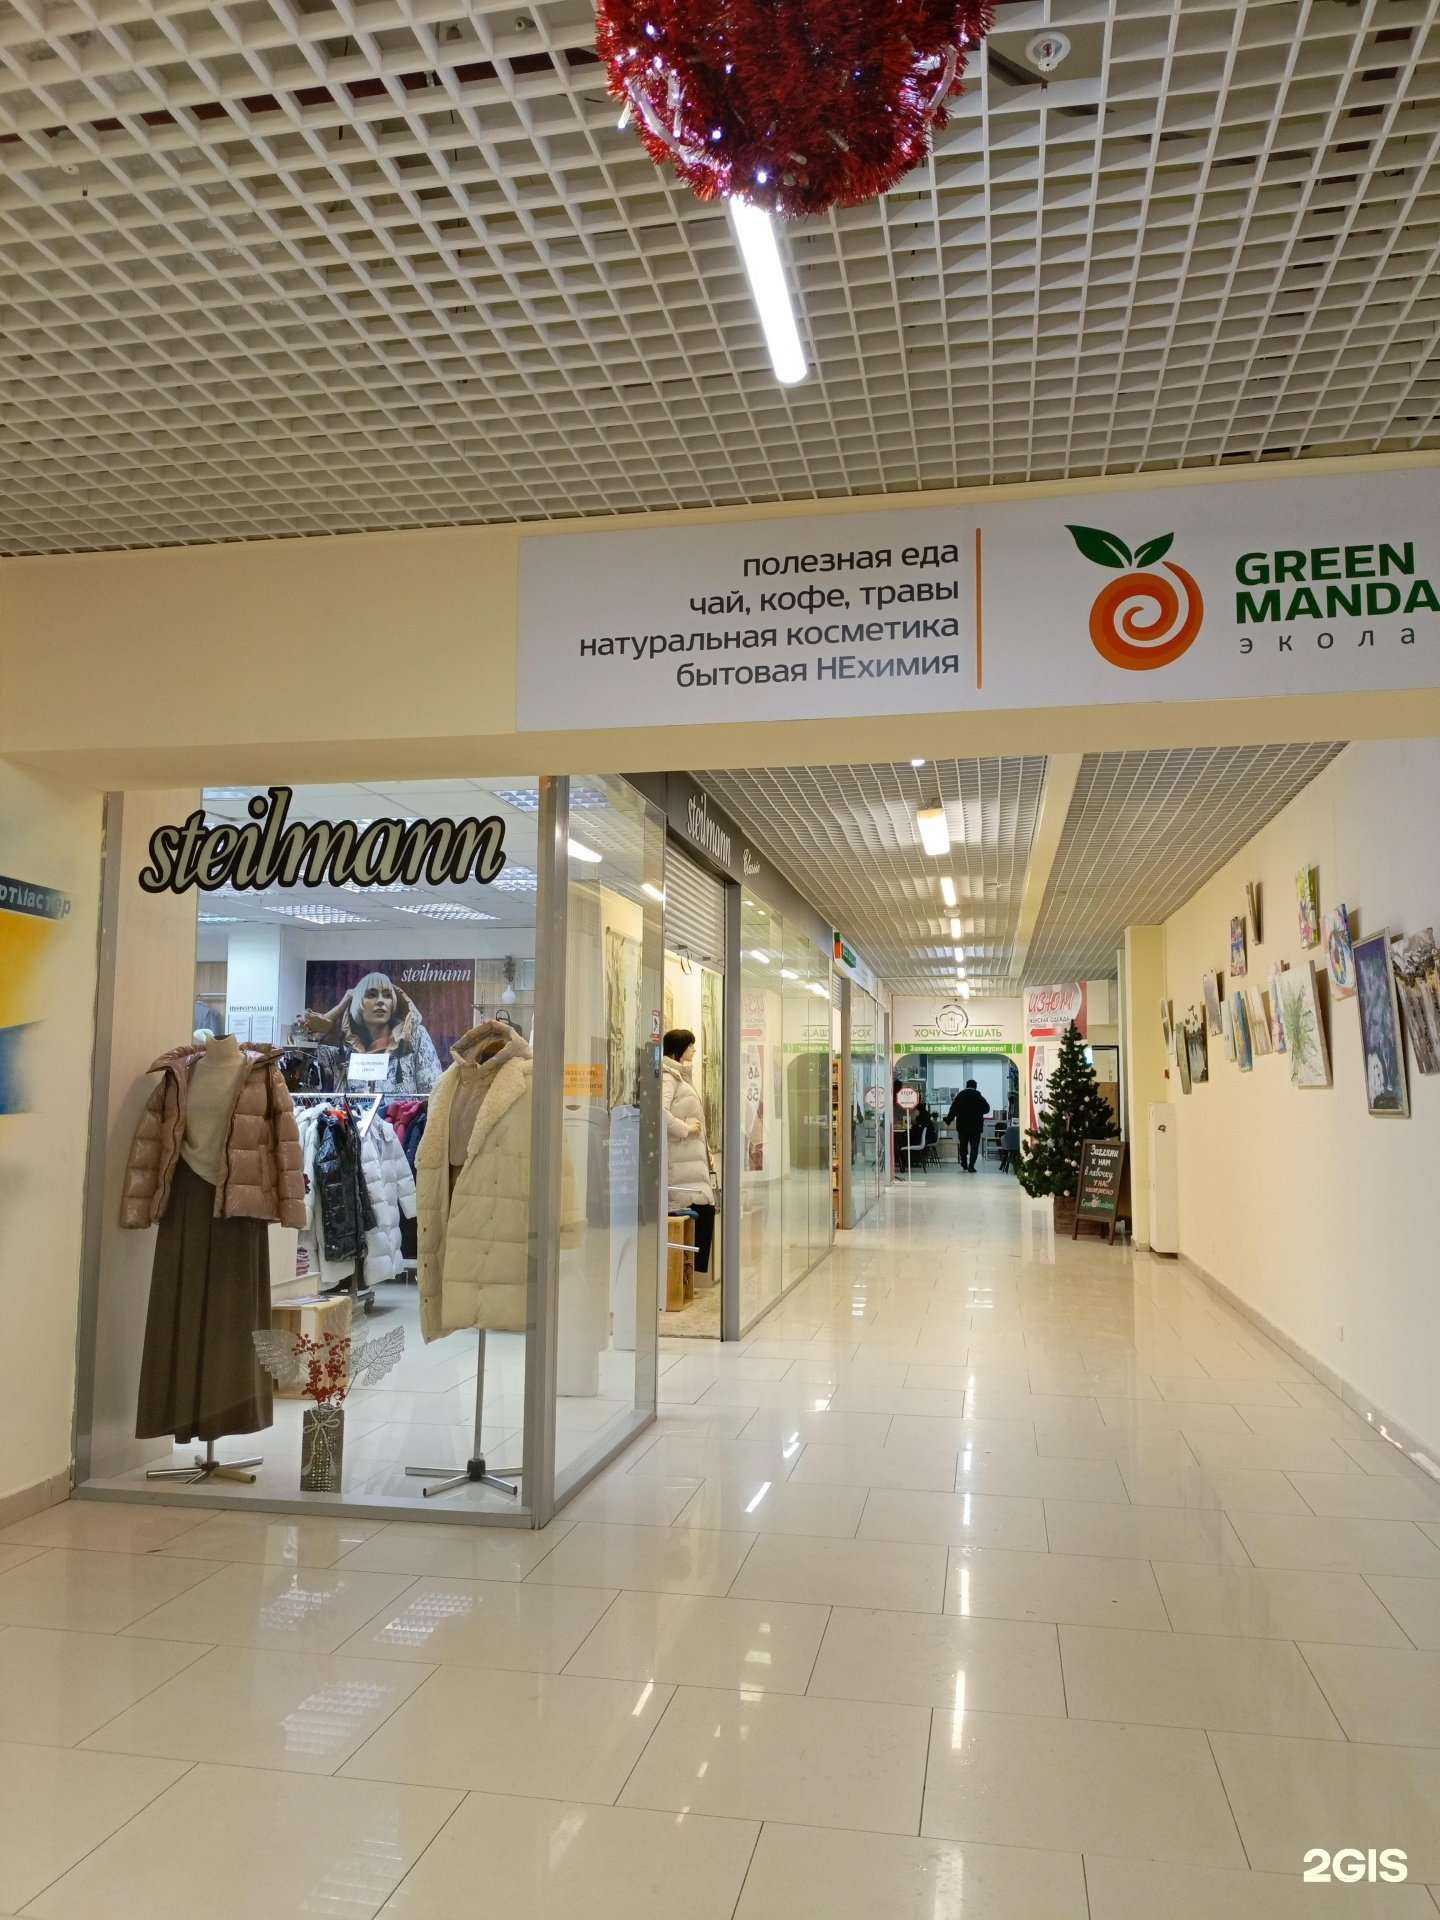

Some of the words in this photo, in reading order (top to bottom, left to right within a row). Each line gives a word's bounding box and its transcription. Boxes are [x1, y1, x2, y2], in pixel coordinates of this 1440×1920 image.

[743, 549, 892, 577] полезная
[901, 544, 959, 568] еда
[1235, 541, 1415, 586] GREEN
[690, 590, 751, 616] чай,
[760, 584, 850, 615] кофе,
[860, 580, 959, 609] травы
[1236, 579, 1440, 625] MANDA
[580, 625, 778, 660] натуральная
[786, 617, 959, 647] косметика
[677, 661, 807, 687] бытовая
[816, 653, 959, 681] НЕхимия
[139, 786, 506, 894] steilmann
[688, 792, 730, 868] steilmann
[401, 962, 472, 982] steilmann
[913, 1028, 941, 1038] ХОЧУ
[961, 1028, 1003, 1038] КУШАТЬ
[1033, 1068, 1044, 1082] 46
[1033, 1090, 1044, 1105] 58
